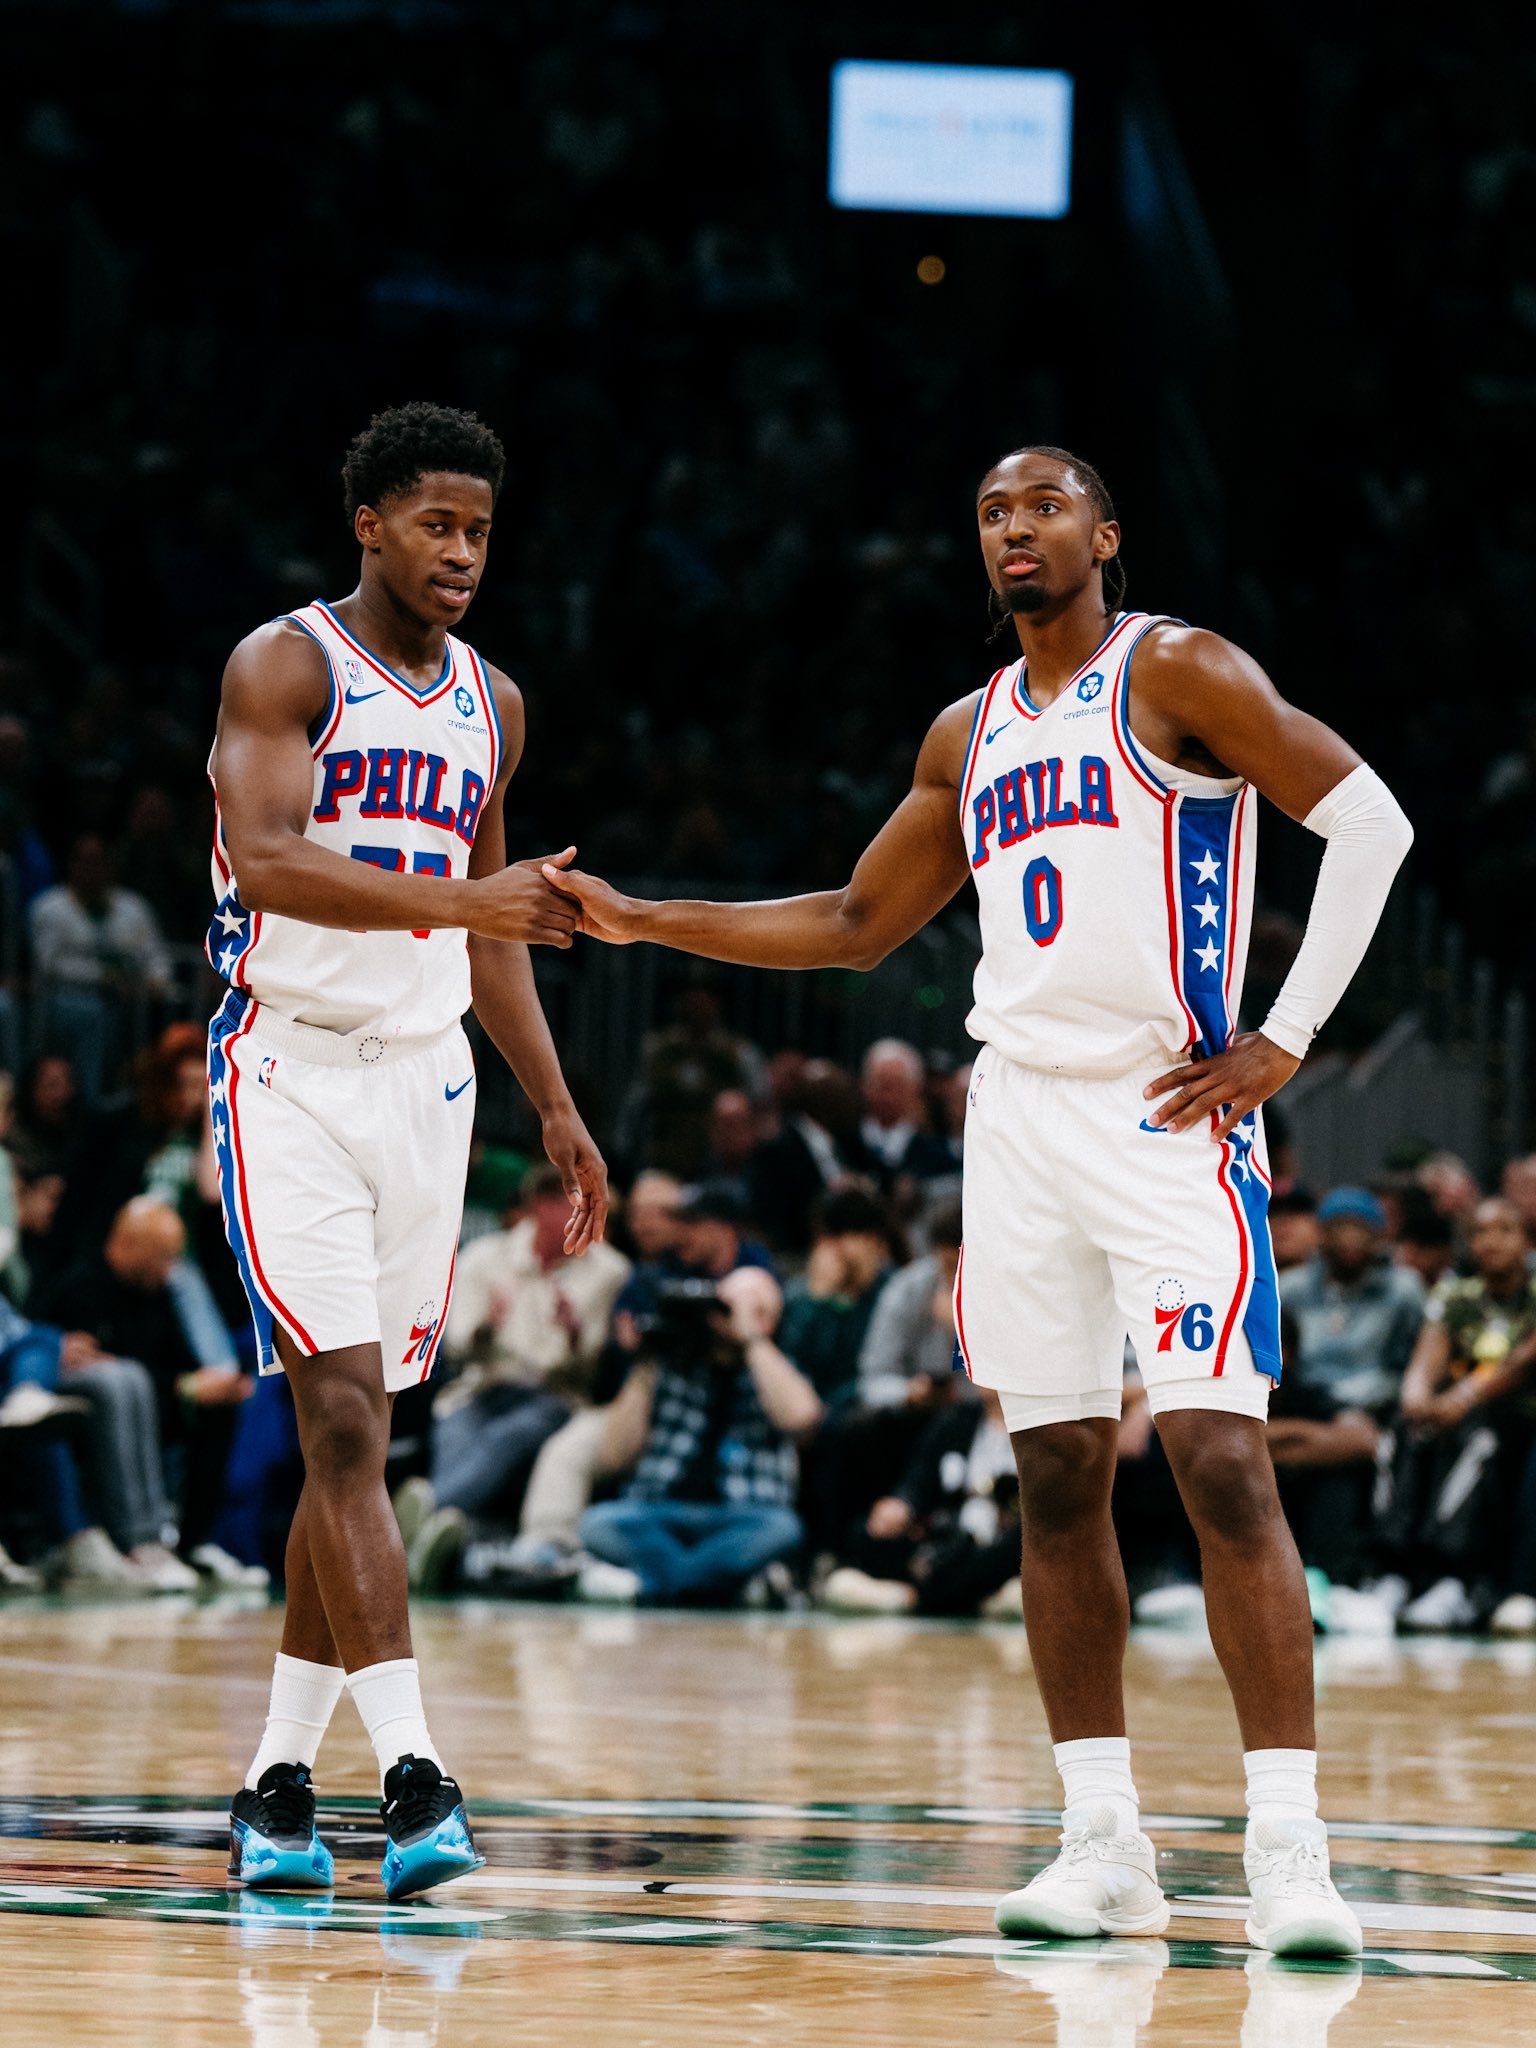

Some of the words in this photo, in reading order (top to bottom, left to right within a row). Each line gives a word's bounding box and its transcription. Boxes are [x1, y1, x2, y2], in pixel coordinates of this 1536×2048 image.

[447, 719, 488, 736] crypto.com
[1063, 705, 1110, 720] crypto.com
[313, 748, 486, 850] PHILA
[971, 755, 1120, 871] PHILA
[1022, 855, 1063, 948] 0
[1155, 1302, 1215, 1354] 76
